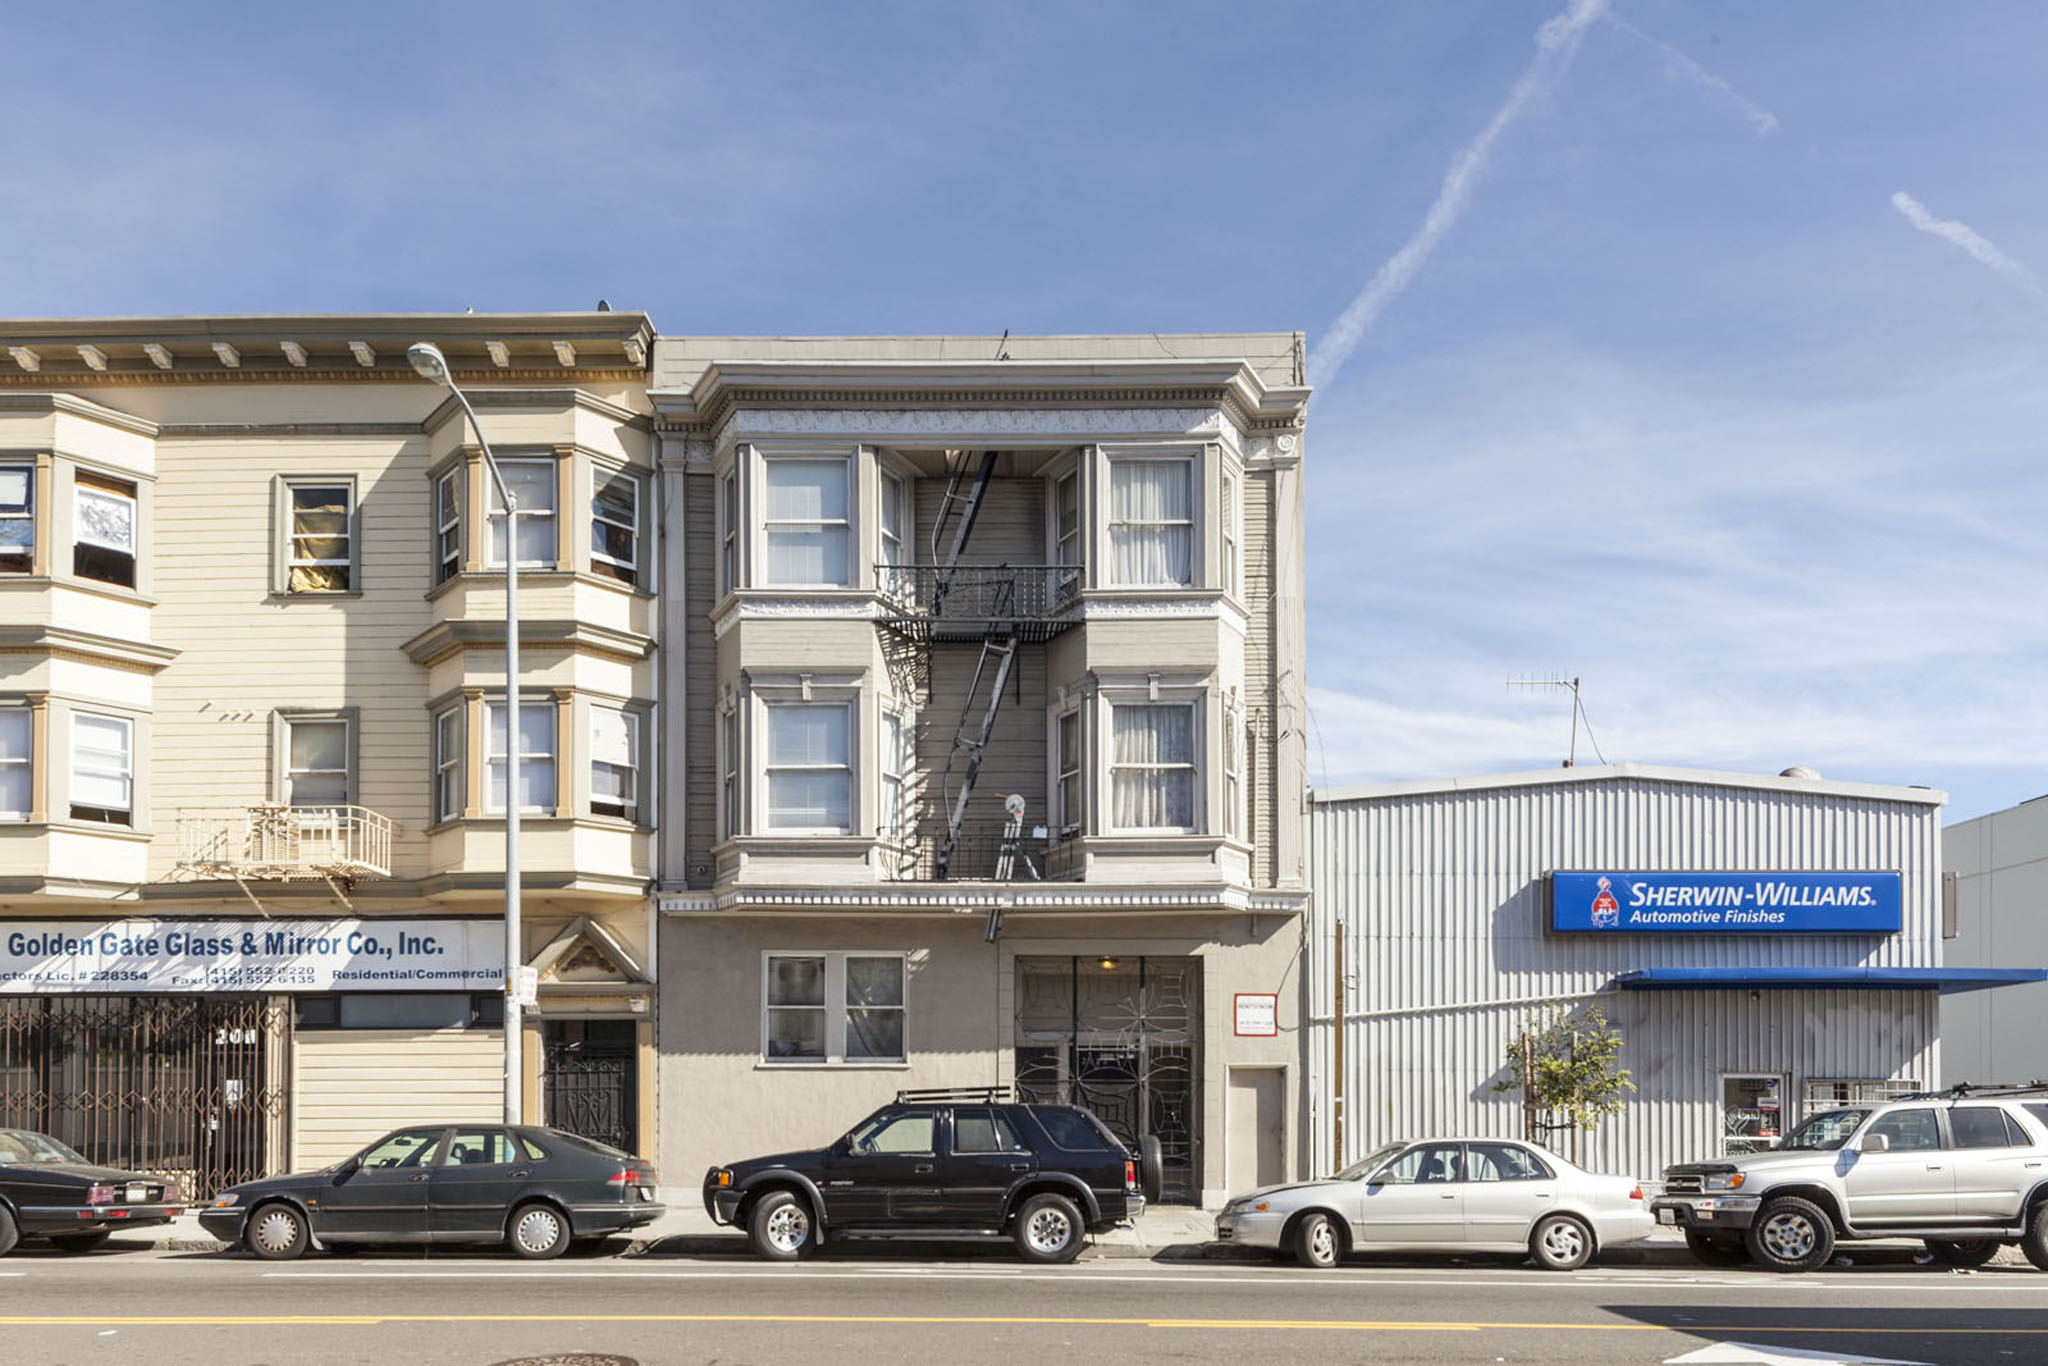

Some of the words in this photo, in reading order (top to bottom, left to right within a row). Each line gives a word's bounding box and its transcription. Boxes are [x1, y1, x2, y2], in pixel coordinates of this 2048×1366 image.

[1629, 909, 1721, 923] Automotive
[1724, 909, 1785, 923] Finishes
[8, 932, 94, 957] Golden
[100, 932, 159, 957] Gate
[165, 931, 234, 956] Glass
[240, 931, 258, 956] &
[265, 931, 341, 956] Mirror
[347, 931, 393, 960] Co.,
[399, 931, 445, 955] Inc.
[0, 970, 42, 981] ctors
[46, 971, 75, 981] Lic.
[78, 971, 87, 981] #
[91, 970, 149, 981] 228354
[332, 969, 503, 980] Residential/Commercial
